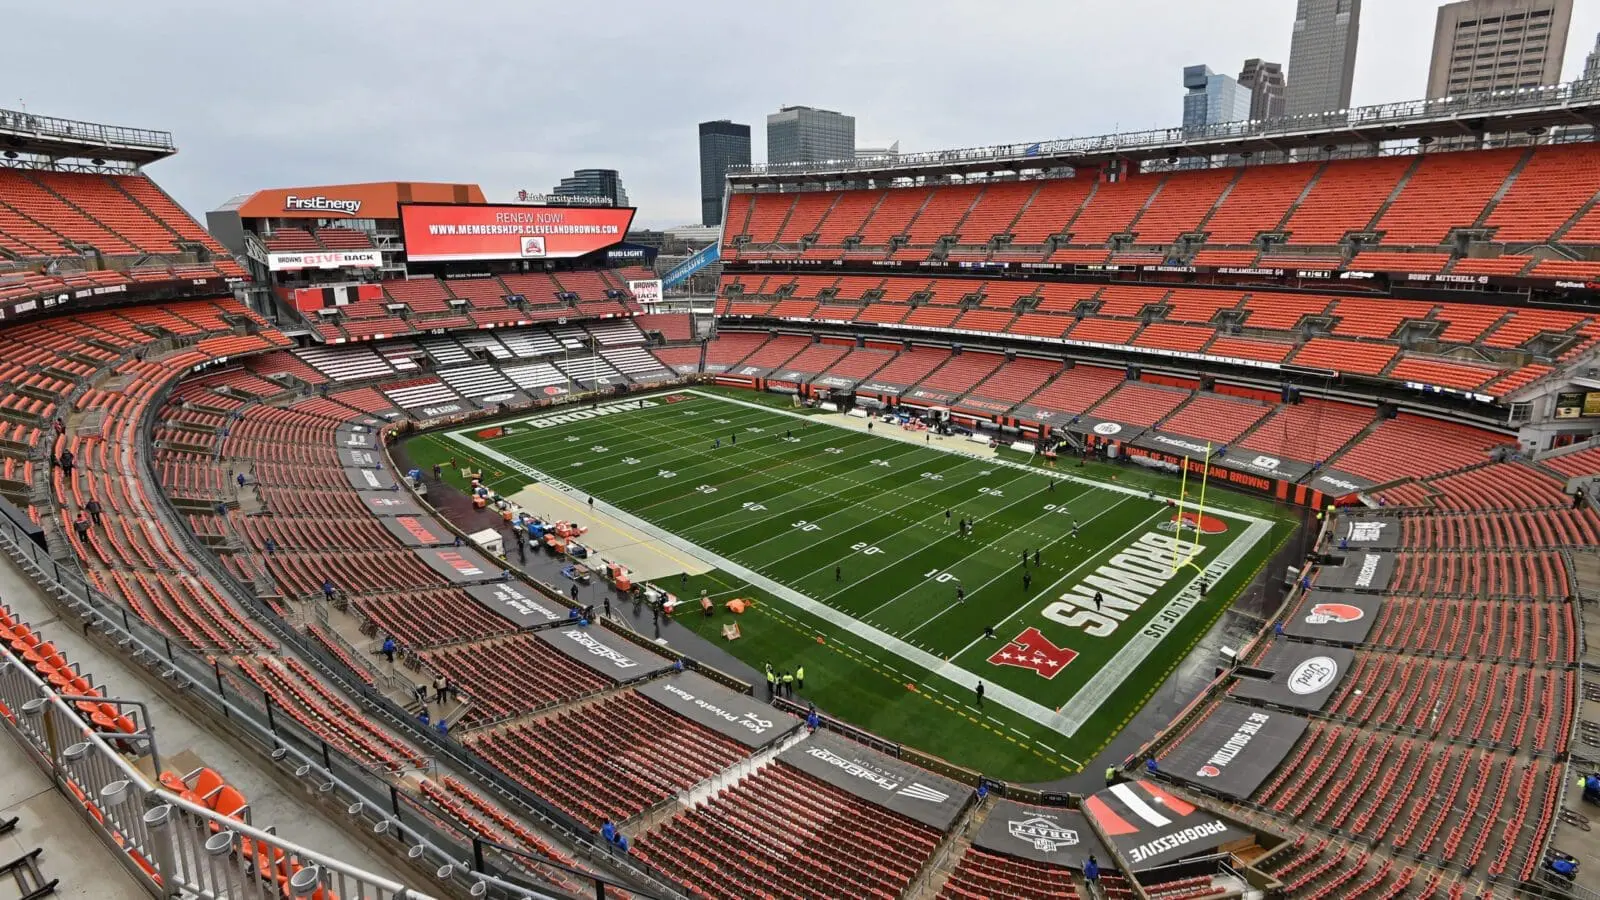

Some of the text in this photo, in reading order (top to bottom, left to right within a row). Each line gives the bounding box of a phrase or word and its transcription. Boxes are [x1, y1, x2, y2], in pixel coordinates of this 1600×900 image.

[286, 196, 361, 212] FirstEnergy
[573, 195, 612, 205] Hospitals
[496, 212, 564, 223] RENEW NOW!
[429, 224, 618, 235] WWW.MEMBERSHIPS.CLEVELANDBROWNS.COM
[303, 254, 344, 265] GIVE
[1435, 274, 1475, 282] MITCHELL
[526, 400, 660, 430] BROWNS
[1126, 447, 1149, 456] HOME
[1151, 452, 1160, 460] OF
[1230, 472, 1270, 490] BROWNS
[696, 484, 718, 494] 50
[1320, 475, 1359, 490] meijer
[792, 520, 816, 532] 30
[851, 542, 880, 555] 20
[1214, 560, 1230, 569] IT
[924, 569, 953, 583] 10
[1041, 532, 1206, 638] BROWNS
[1171, 592, 1197, 608] ALL
[1160, 609, 1180, 623] OF
[1144, 623, 1167, 638] US
[562, 630, 637, 668] FirstEnergy
[1296, 663, 1330, 687] Ford
[664, 684, 766, 734] Key Private Bank
[1248, 712, 1269, 723] BE
[1238, 721, 1262, 736] THE
[805, 747, 898, 790] FirstEnergy
[854, 758, 904, 782] STADIUM
[1015, 825, 1072, 839] DRAFT
[1129, 820, 1228, 863] PROGRESSIVE
